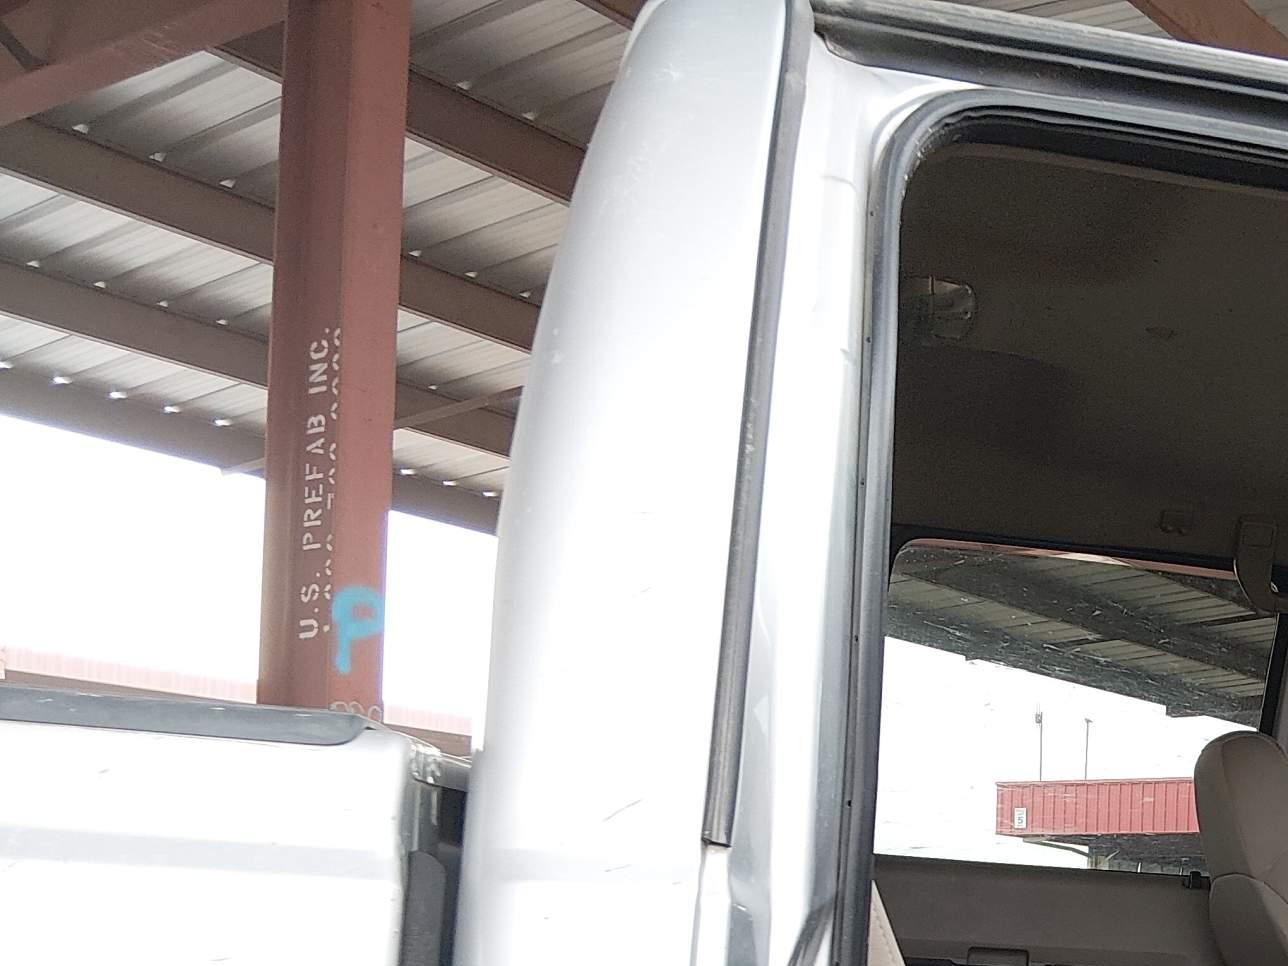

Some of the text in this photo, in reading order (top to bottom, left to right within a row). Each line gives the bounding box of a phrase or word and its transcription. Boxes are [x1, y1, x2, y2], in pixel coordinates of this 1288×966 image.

[299, 327, 330, 639] U.S. PREFAB INC.
[331, 585, 385, 676] P
